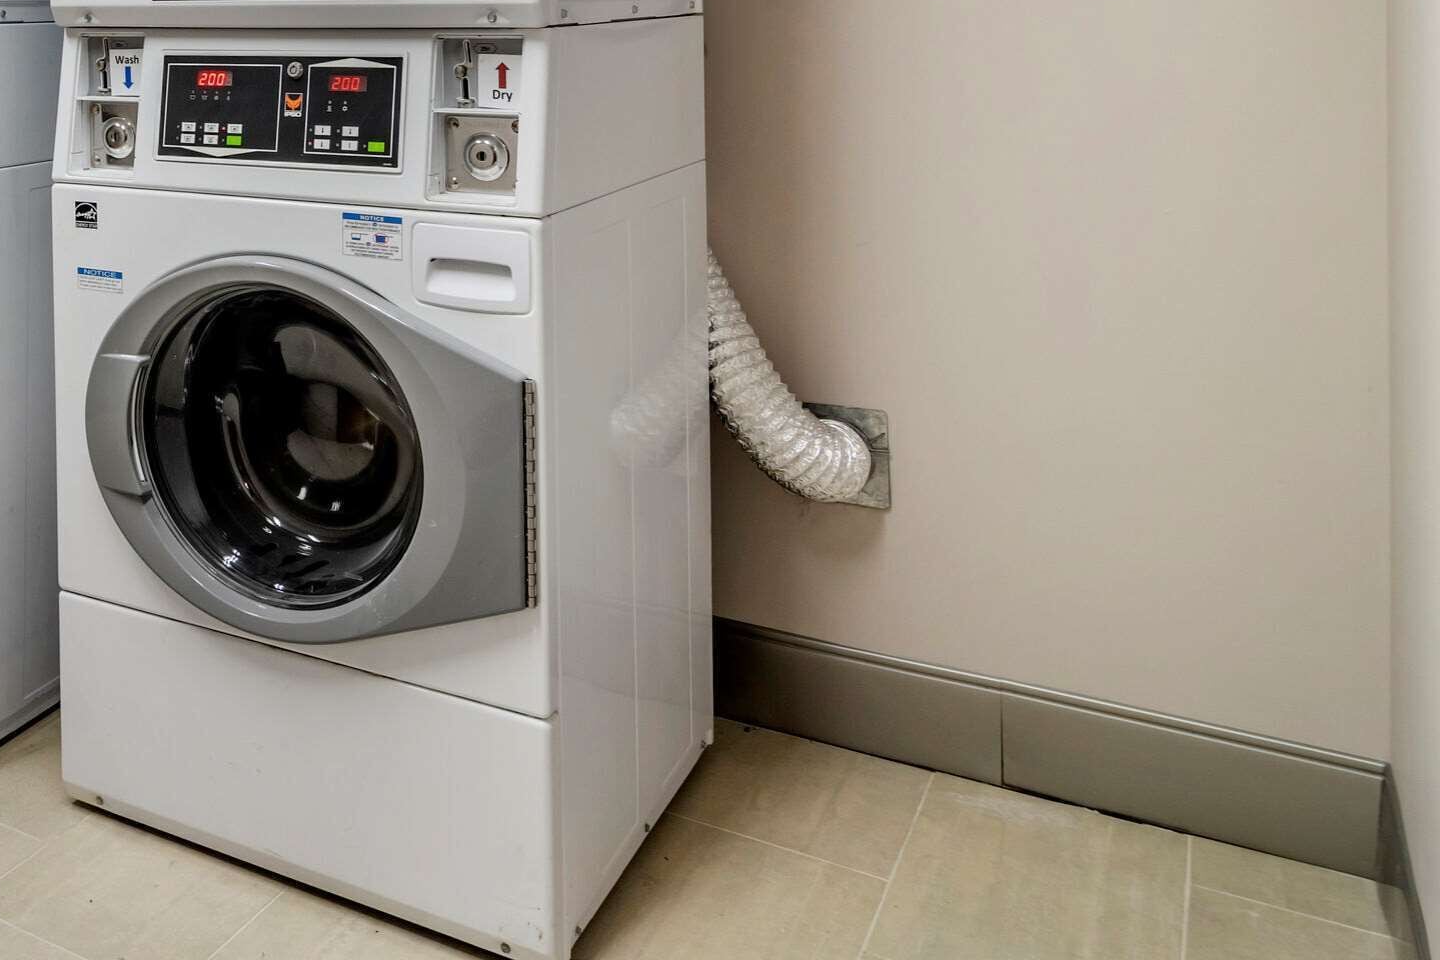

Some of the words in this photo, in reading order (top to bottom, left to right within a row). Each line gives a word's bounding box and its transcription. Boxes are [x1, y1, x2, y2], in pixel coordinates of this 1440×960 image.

[115, 55, 139, 64] Wash
[492, 89, 512, 102] Dry
[83, 269, 116, 278] NOTICE
